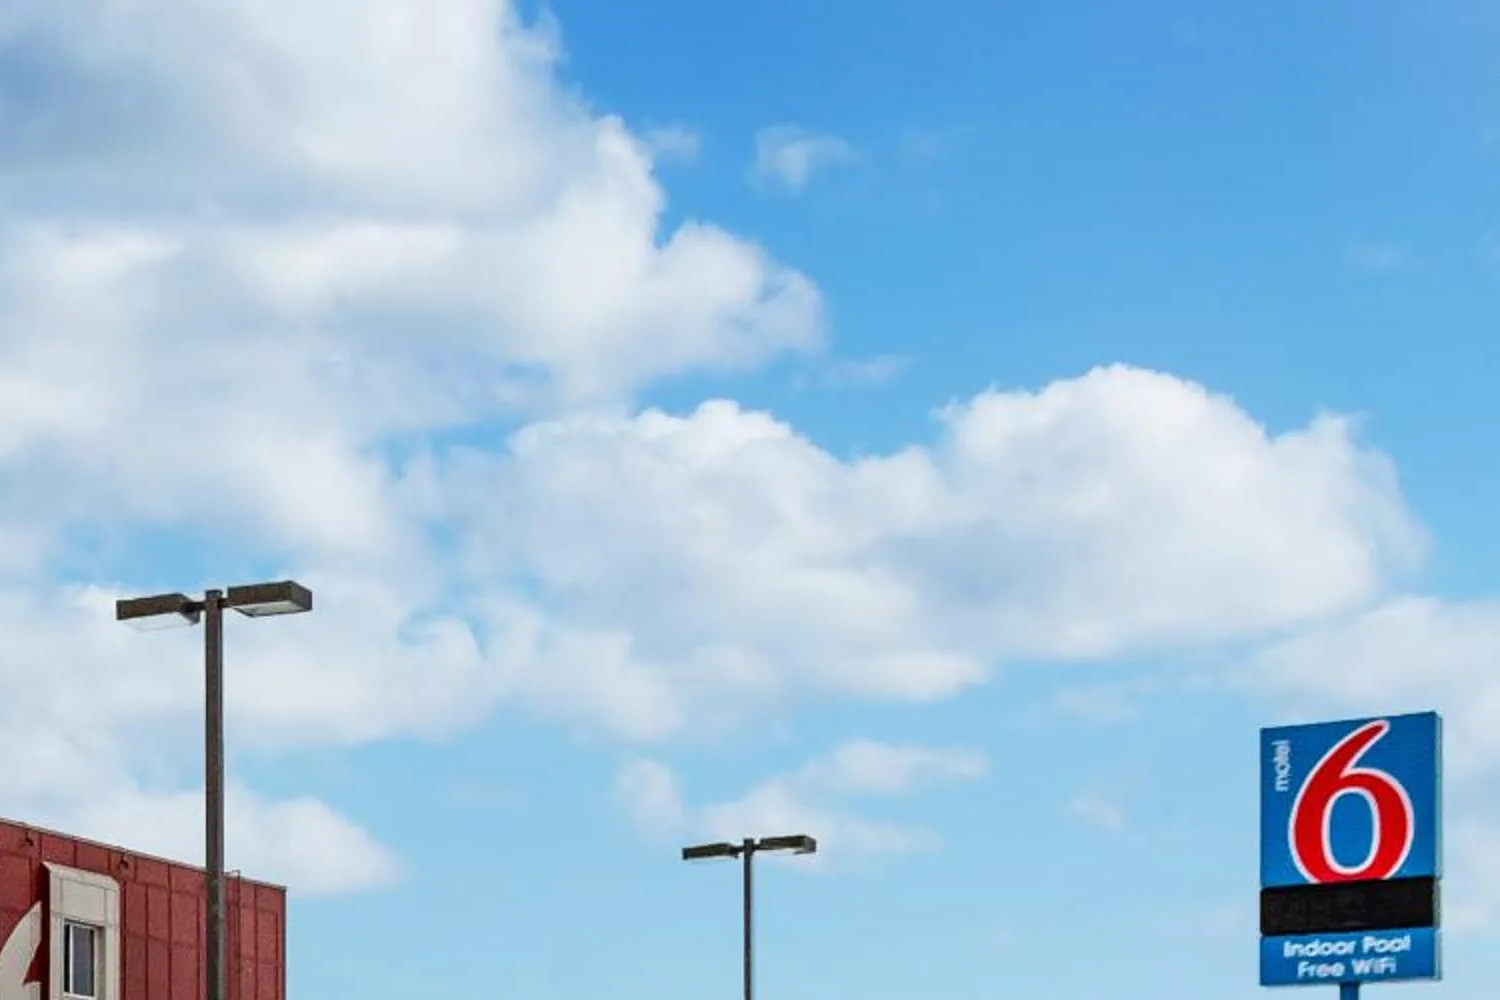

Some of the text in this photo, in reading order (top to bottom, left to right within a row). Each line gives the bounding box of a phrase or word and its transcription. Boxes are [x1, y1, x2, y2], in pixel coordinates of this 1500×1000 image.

[1272, 719, 1414, 884] motel 6
[1283, 934, 1411, 958] Indoor Pool
[1297, 960, 1345, 978] Free
